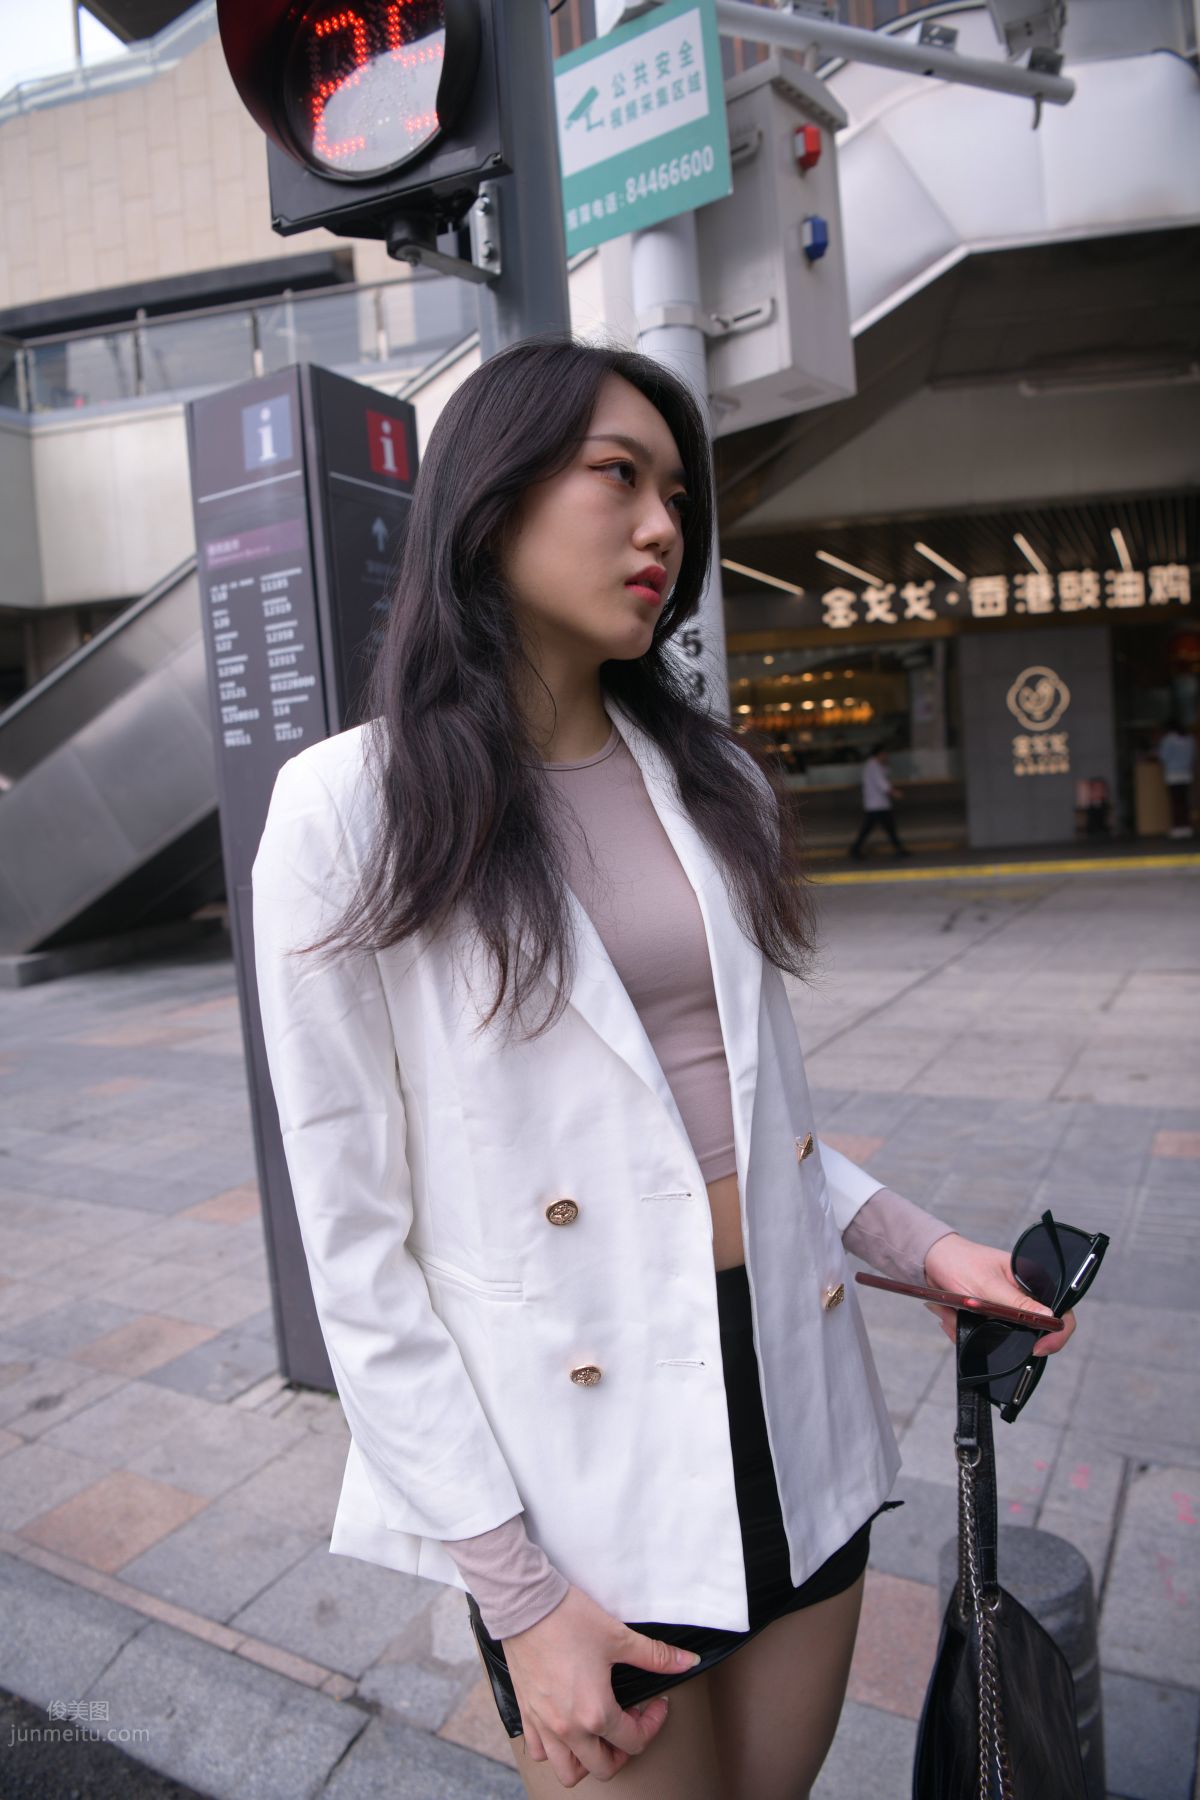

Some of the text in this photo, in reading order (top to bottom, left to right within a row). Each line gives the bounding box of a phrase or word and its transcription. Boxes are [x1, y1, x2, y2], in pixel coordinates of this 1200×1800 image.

[610, 40, 695, 99] 公共安全
[625, 145, 715, 203] 84466600
